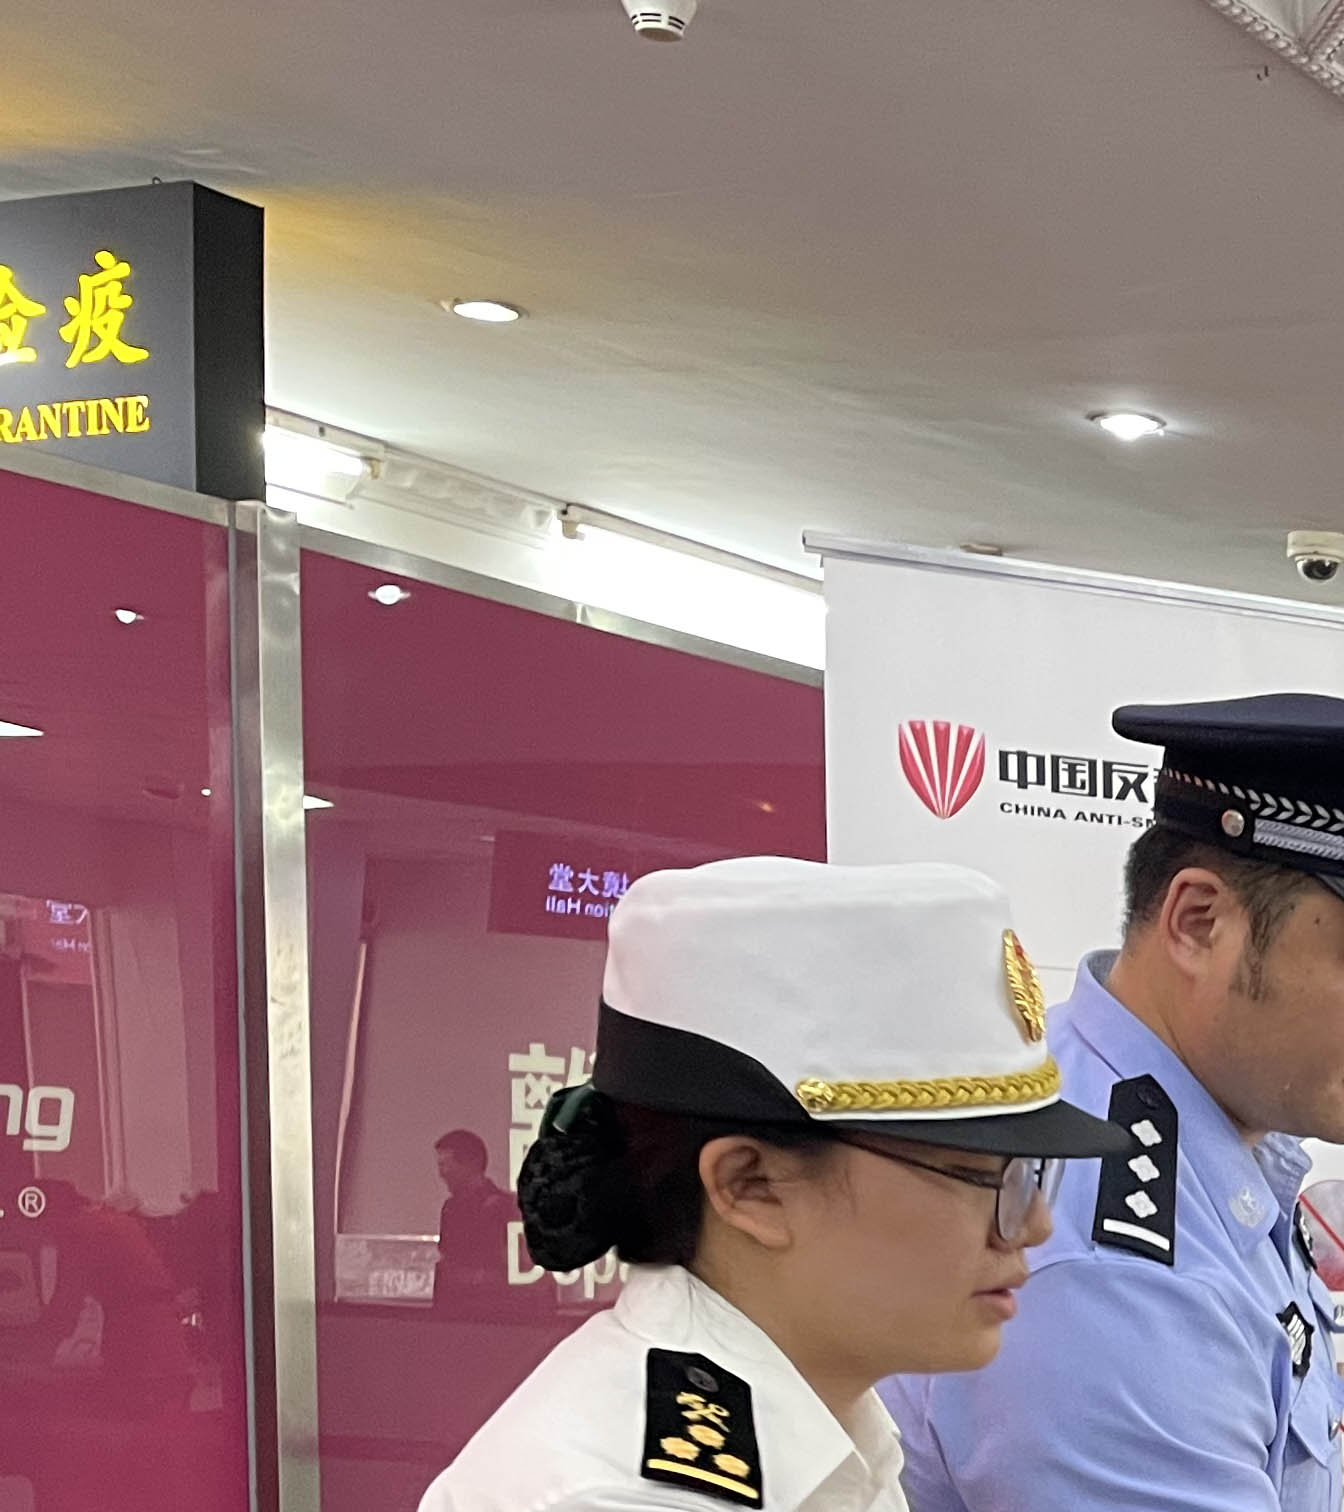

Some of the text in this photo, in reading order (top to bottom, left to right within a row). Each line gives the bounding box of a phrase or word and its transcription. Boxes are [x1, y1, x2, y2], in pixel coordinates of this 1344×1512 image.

[998, 749, 1160, 804] 中国反
[1000, 801, 1067, 821] CHINA
